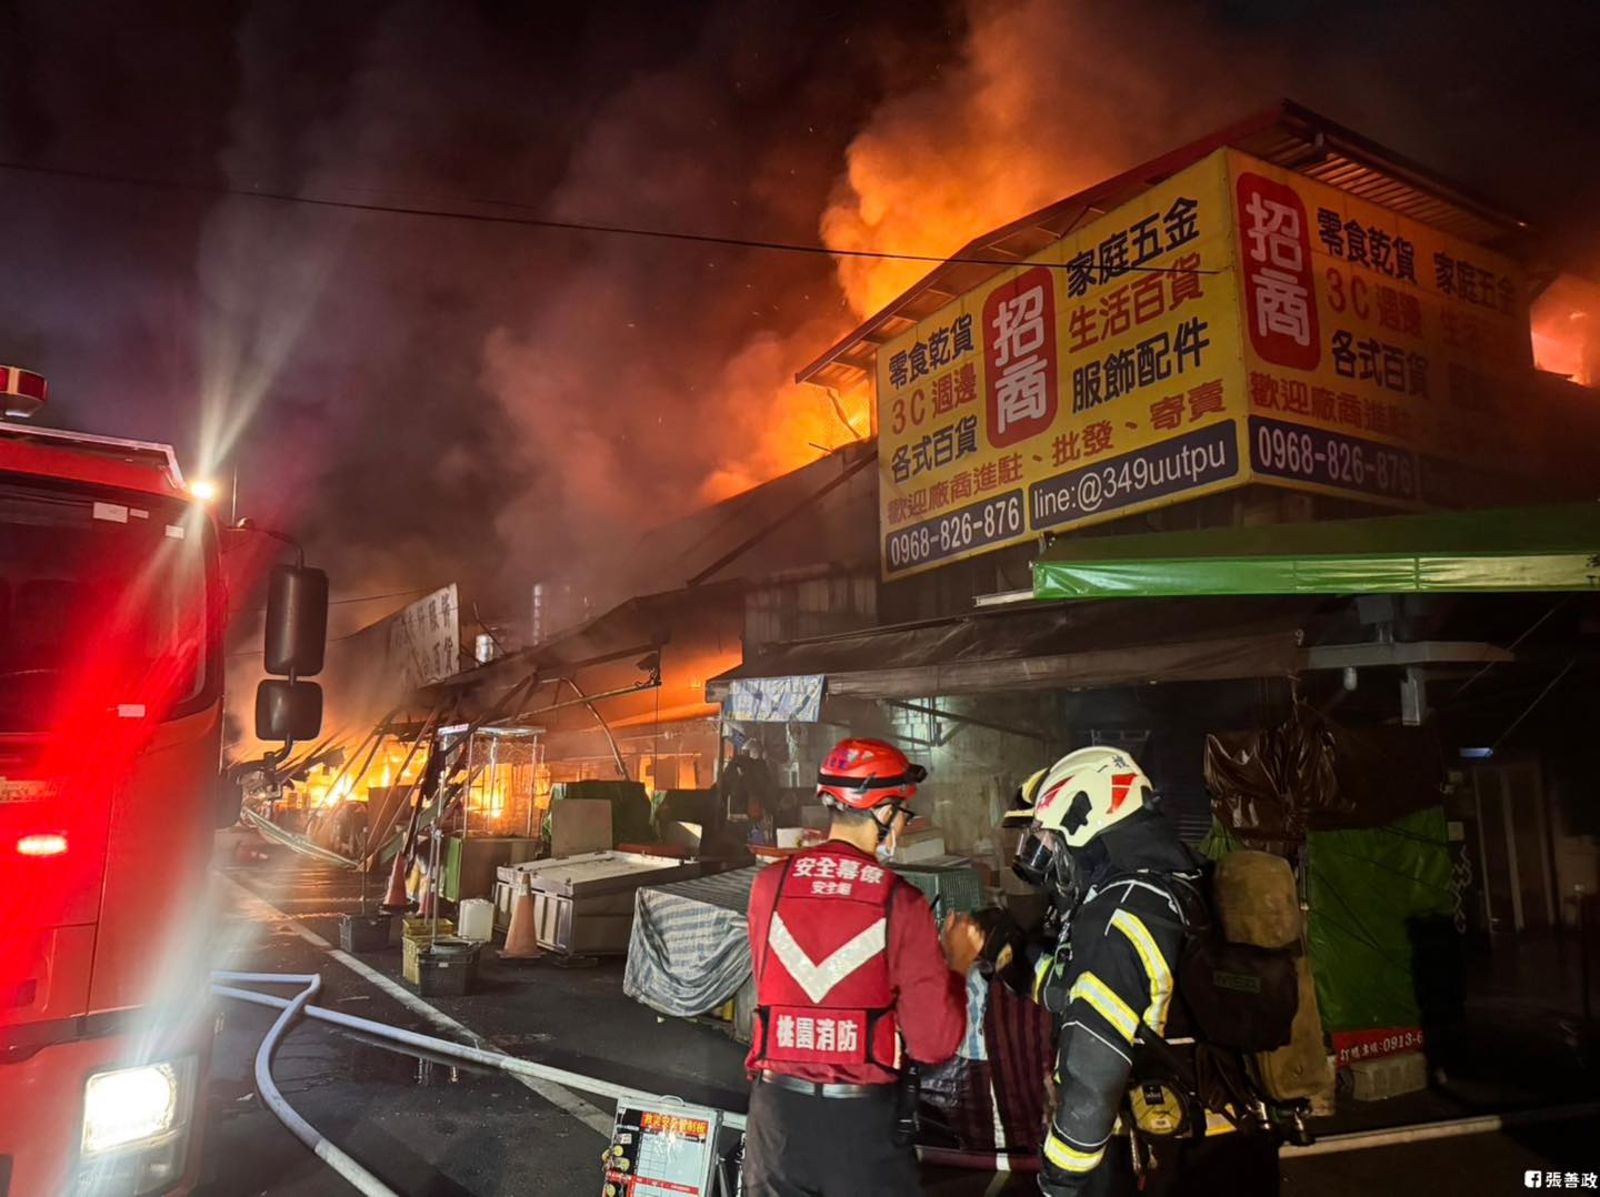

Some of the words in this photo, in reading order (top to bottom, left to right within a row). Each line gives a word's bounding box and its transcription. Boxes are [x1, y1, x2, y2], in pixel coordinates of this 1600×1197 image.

[1065, 196, 1200, 299] 家庭五金
[1246, 192, 1312, 348] 招商
[1317, 207, 1418, 287] 零食乾貨
[1067, 251, 1204, 355] 生活百貨
[888, 312, 974, 390] 零食乾貨
[992, 284, 1049, 436] 招商
[1072, 316, 1210, 414] 服飾配件
[1331, 329, 1431, 401] 各式百貨
[890, 414, 979, 485] 各式百貨
[1032, 440, 1227, 521] line:@349uutpu
[1258, 425, 1413, 496] 0968-826-876
[890, 495, 1021, 567] 0968-826-876
[792, 856, 885, 884] 安全幕僚
[777, 1014, 858, 1053] 桃園消防
